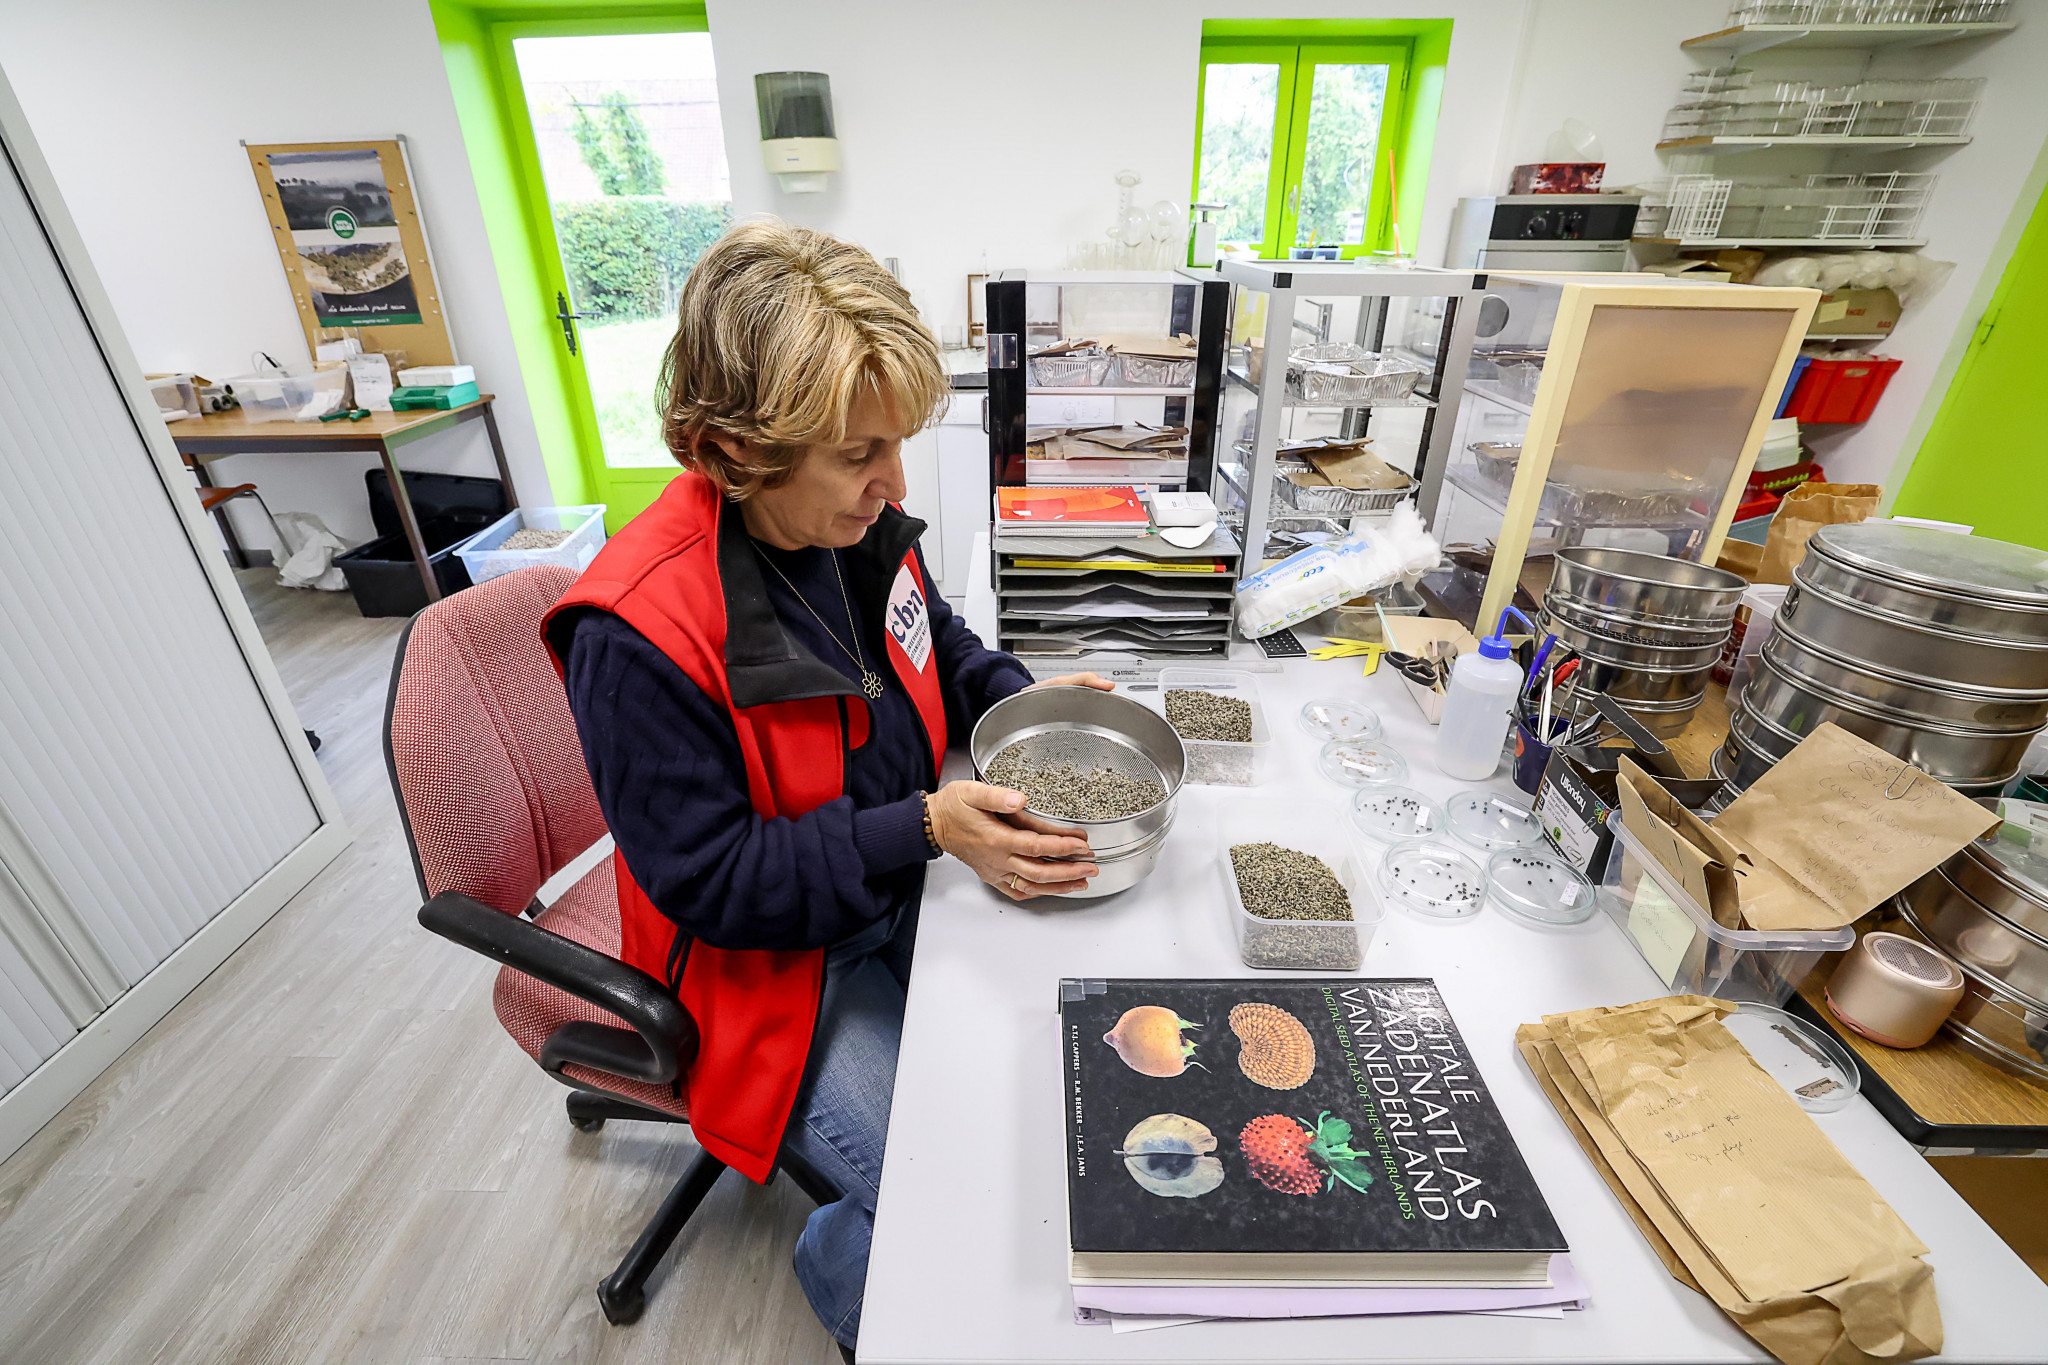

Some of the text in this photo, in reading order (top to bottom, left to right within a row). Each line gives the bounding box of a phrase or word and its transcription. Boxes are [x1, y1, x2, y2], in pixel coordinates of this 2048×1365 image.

[1072, 1042, 1081, 1071] CAPPERS
[1321, 987, 1416, 1220] DIGITAL SEED ATLAS OF THE NETHERLANDS
[1340, 987, 1449, 1221] VAN NEDERLAND
[1367, 988, 1497, 1220] ZADENATLAS
[1404, 988, 1480, 1104] DIGITALE
[1075, 1096, 1083, 1124] BEKKER
[1078, 1156, 1086, 1177] JANS
